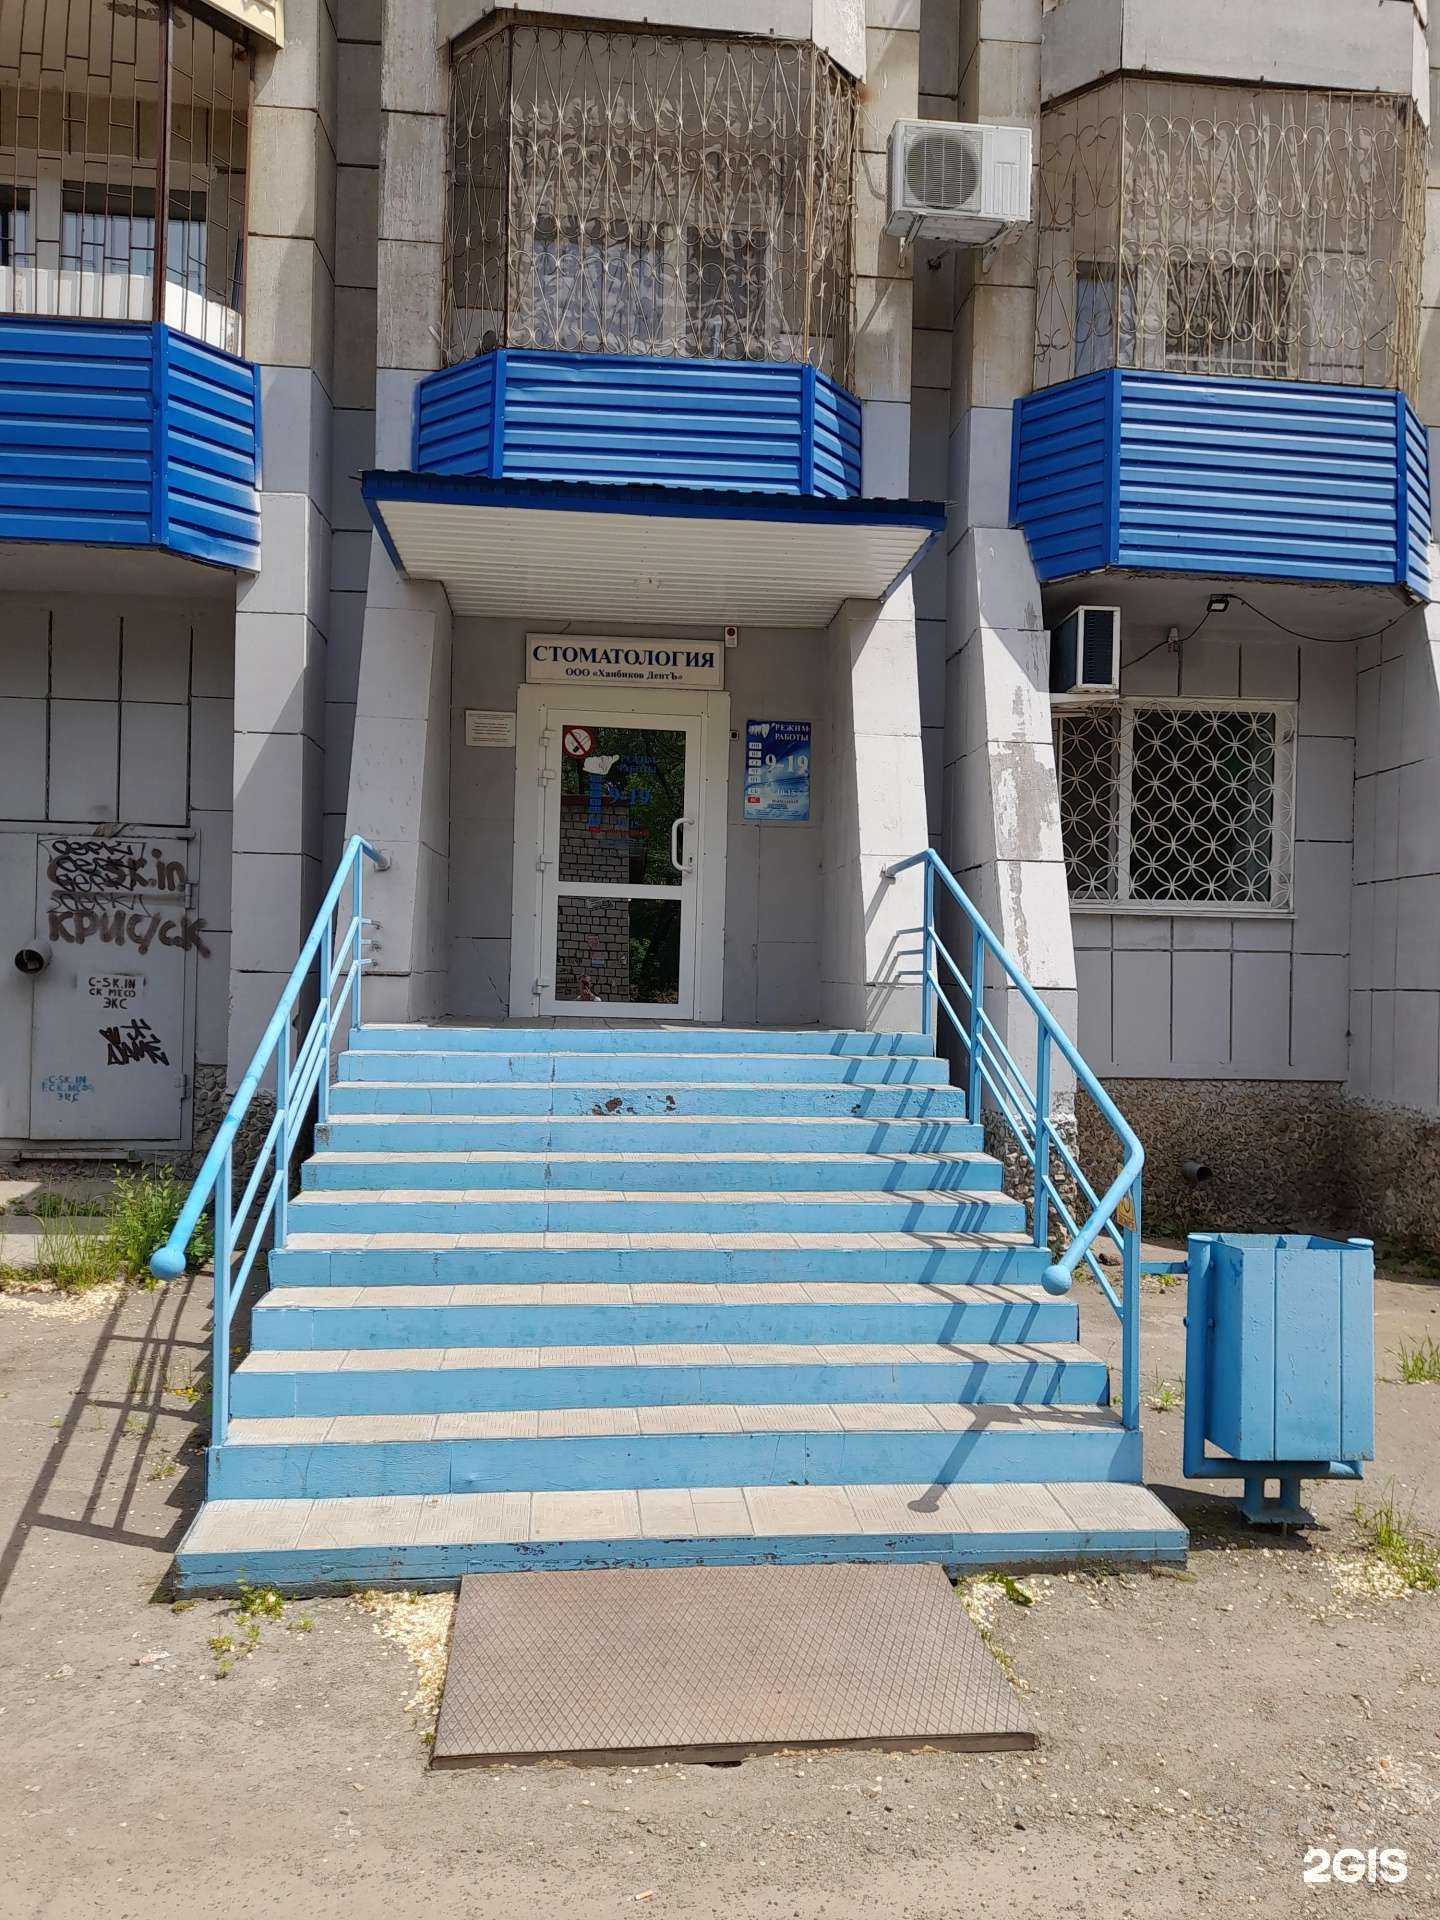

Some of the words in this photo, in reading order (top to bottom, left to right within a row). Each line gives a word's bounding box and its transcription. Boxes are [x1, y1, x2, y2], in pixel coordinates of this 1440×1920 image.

[532, 645, 715, 668] СТОМАТОЛОГИЯ
[565, 668, 591, 678] ООО
[775, 724, 810, 732] РЕЖИМ
[775, 733, 809, 741] РАБОТЫ
